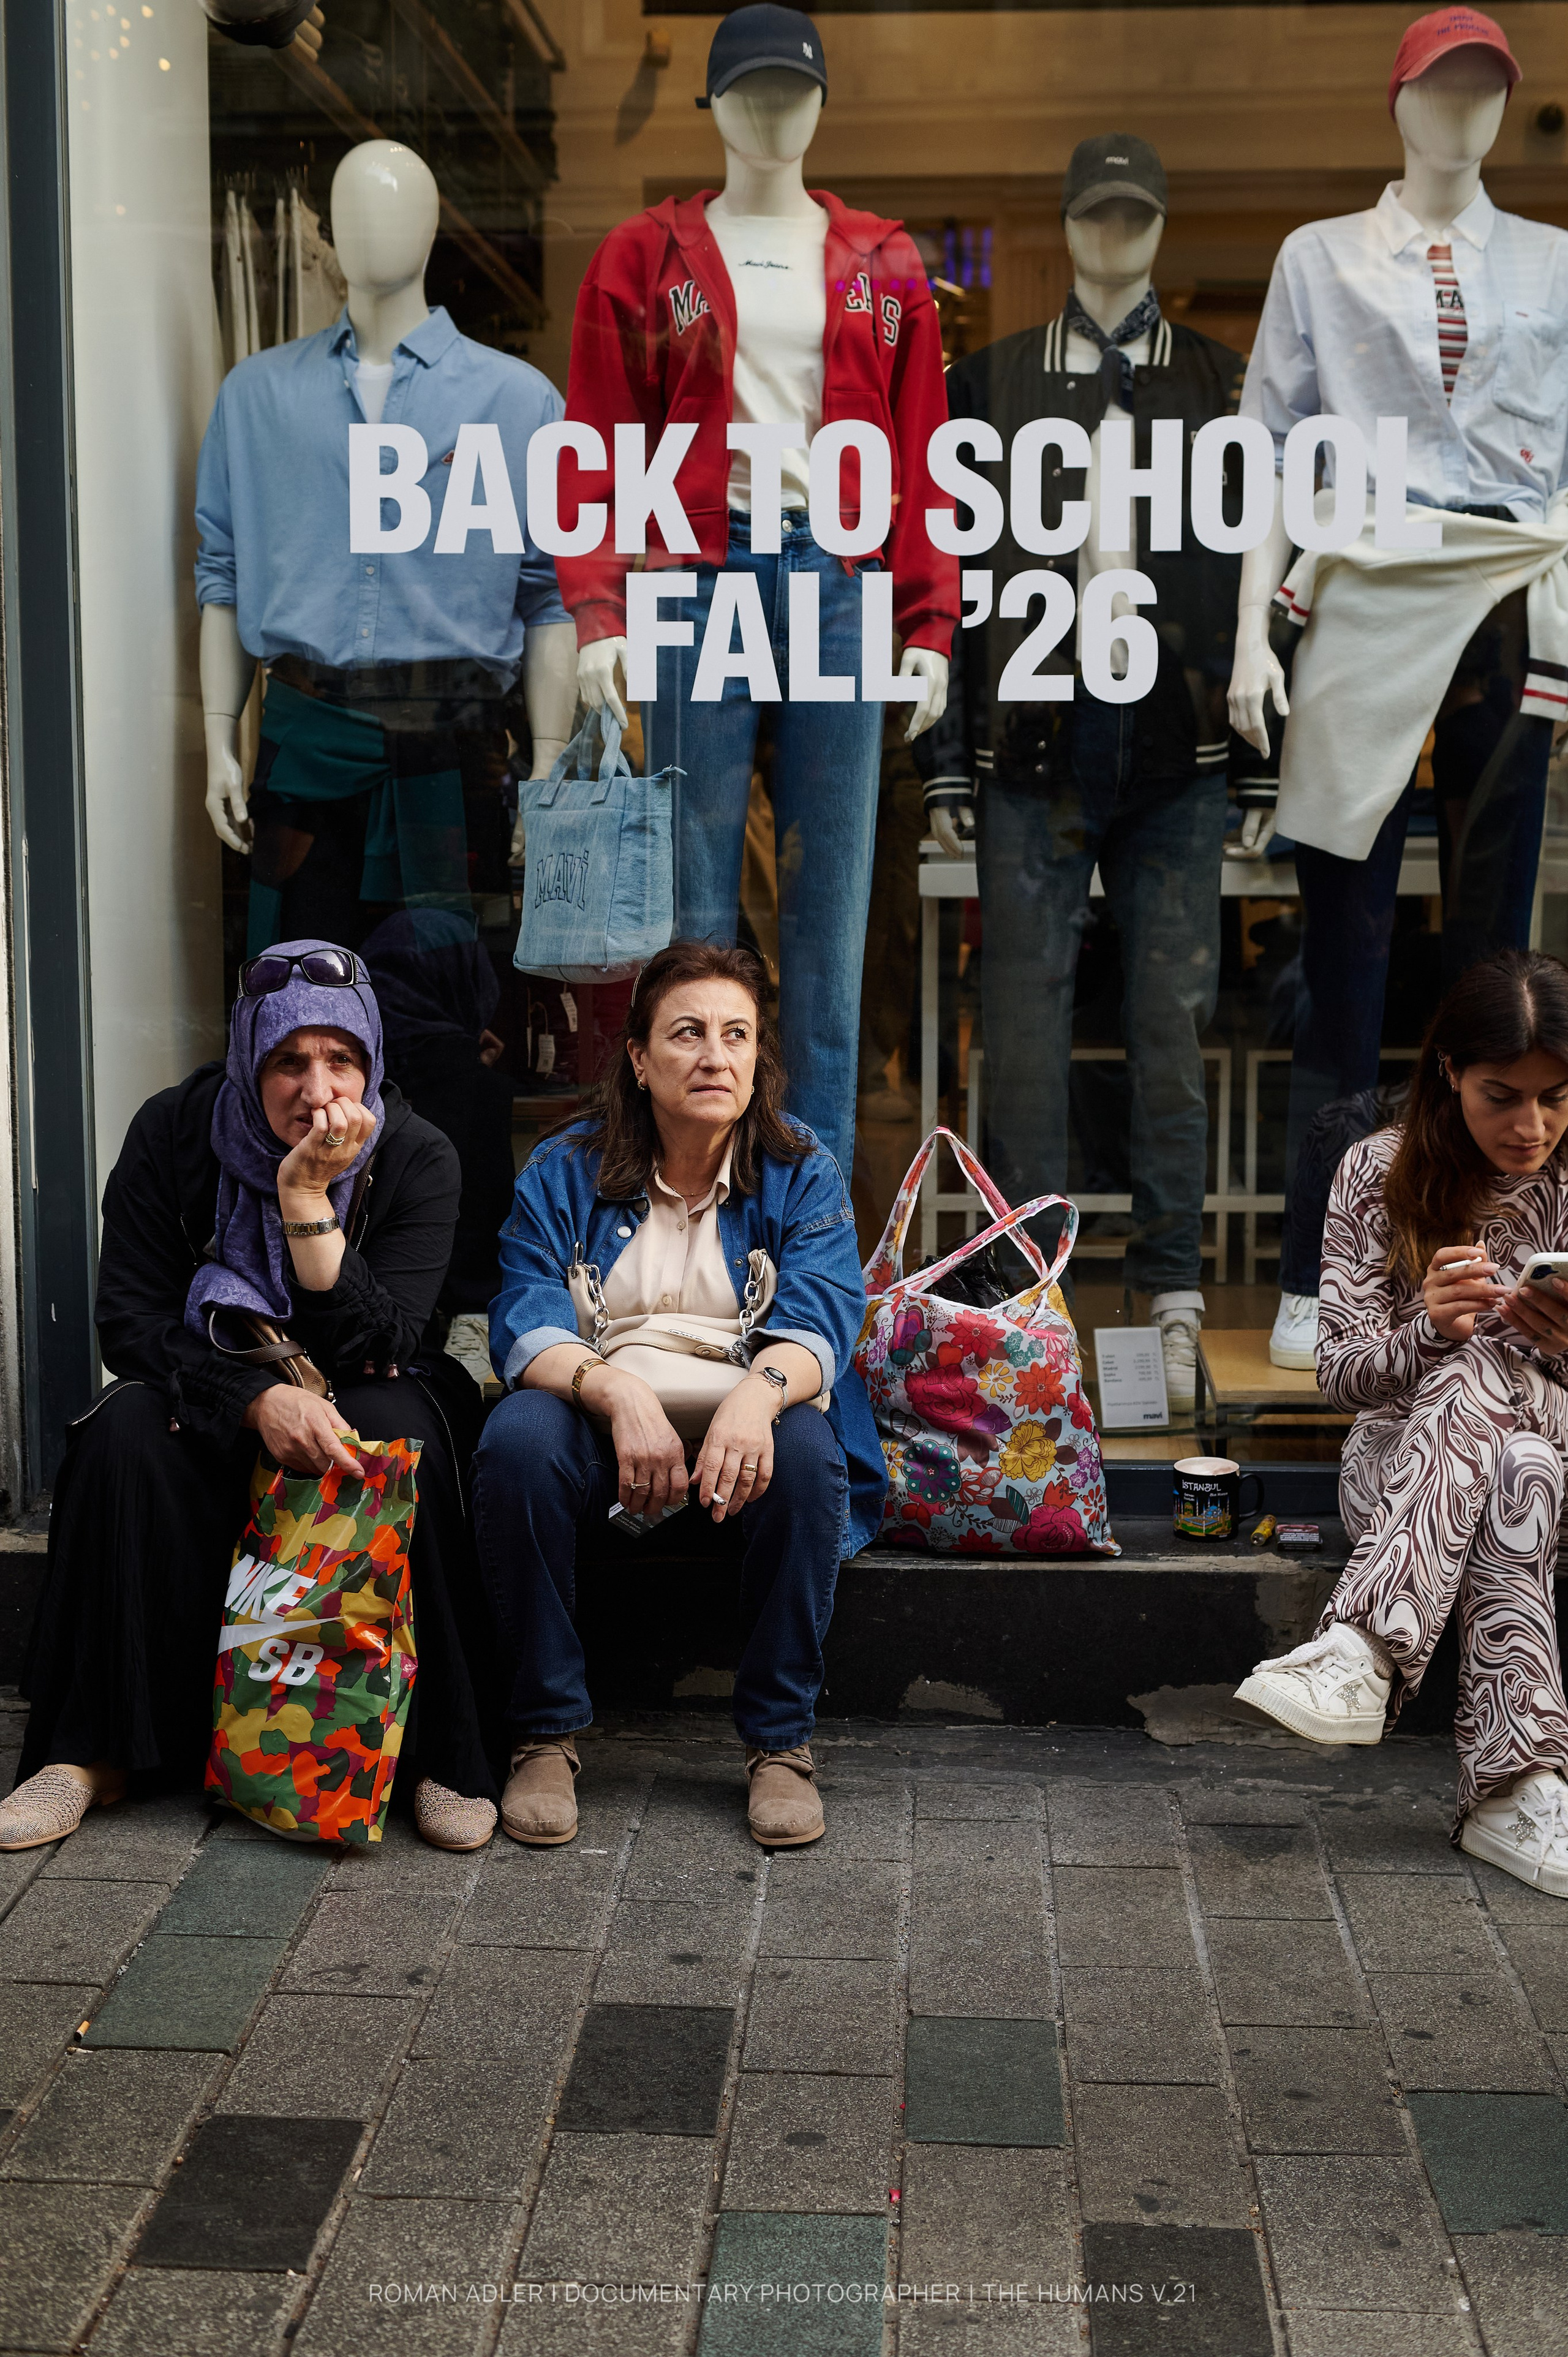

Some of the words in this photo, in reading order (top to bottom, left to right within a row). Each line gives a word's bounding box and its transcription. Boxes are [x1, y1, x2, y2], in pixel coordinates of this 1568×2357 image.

[349, 420, 701, 557] BACK
[726, 419, 892, 556] TO
[925, 415, 1443, 556] SCHOOL
[626, 571, 929, 703] FALL
[224, 1553, 318, 1623] NIKE
[248, 1638, 324, 1686] SB
